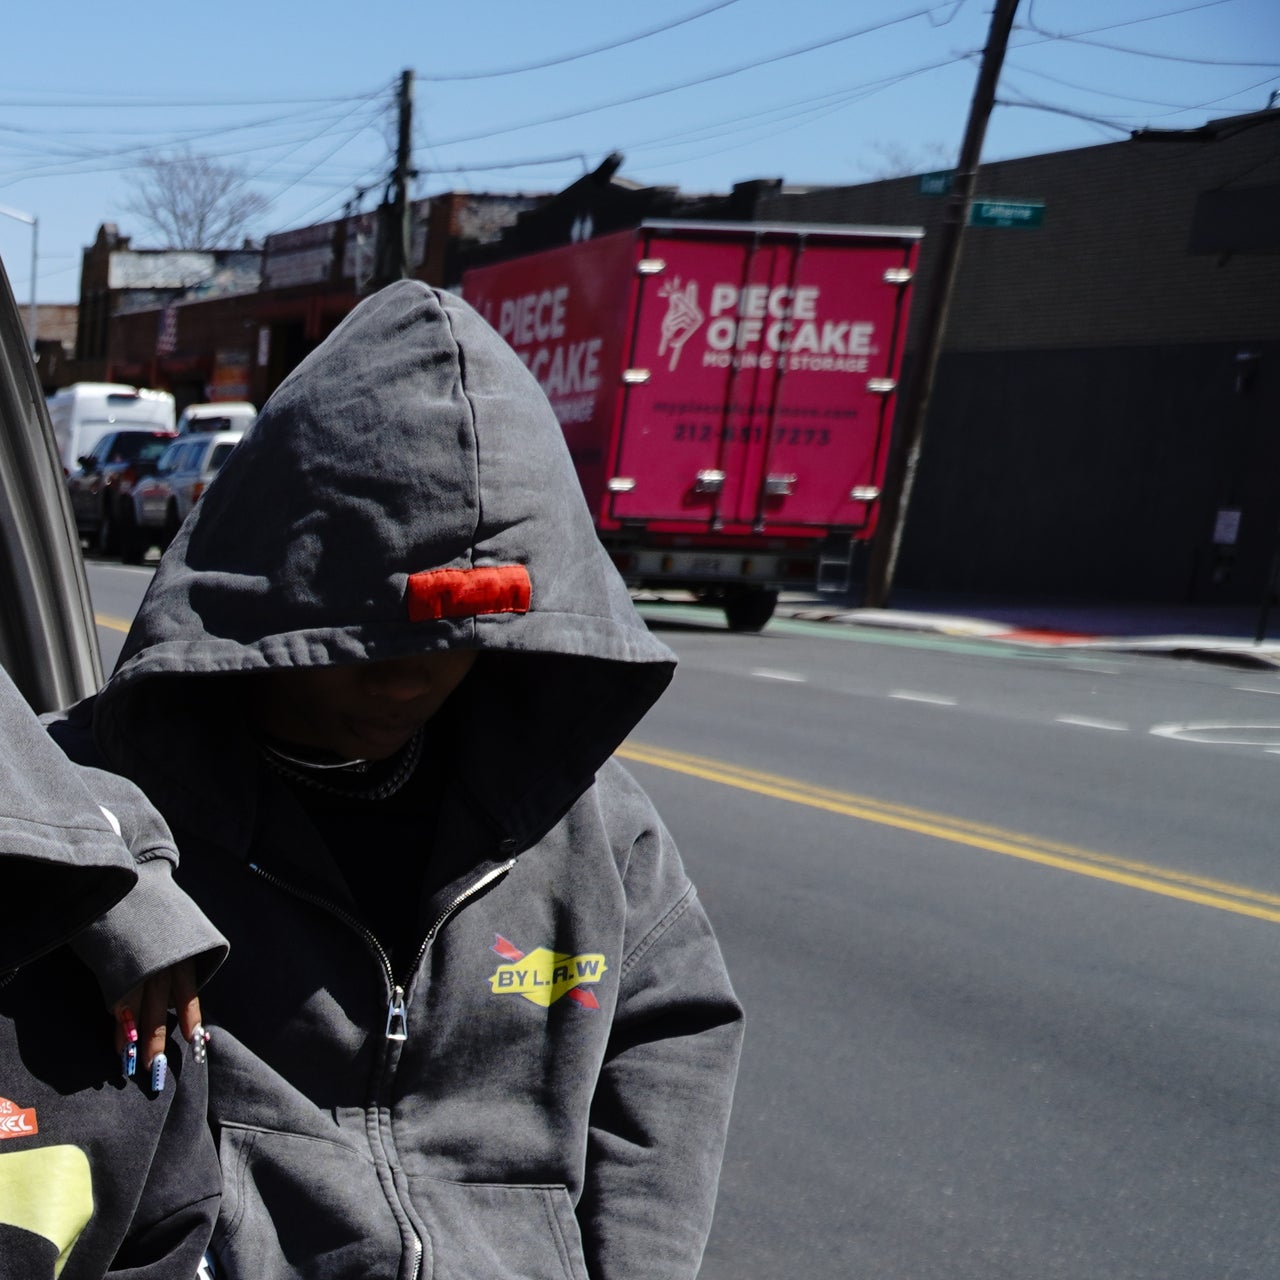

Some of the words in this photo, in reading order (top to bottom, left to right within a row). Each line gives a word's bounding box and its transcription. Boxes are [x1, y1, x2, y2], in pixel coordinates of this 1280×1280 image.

[500, 287, 570, 345] PIECE
[710, 283, 820, 320] PIECE
[706, 317, 763, 351] OF
[765, 321, 874, 356] CAKE
[531, 336, 602, 397] CAKE
[790, 356, 870, 373] STORAGE
[498, 970, 528, 987] BY
